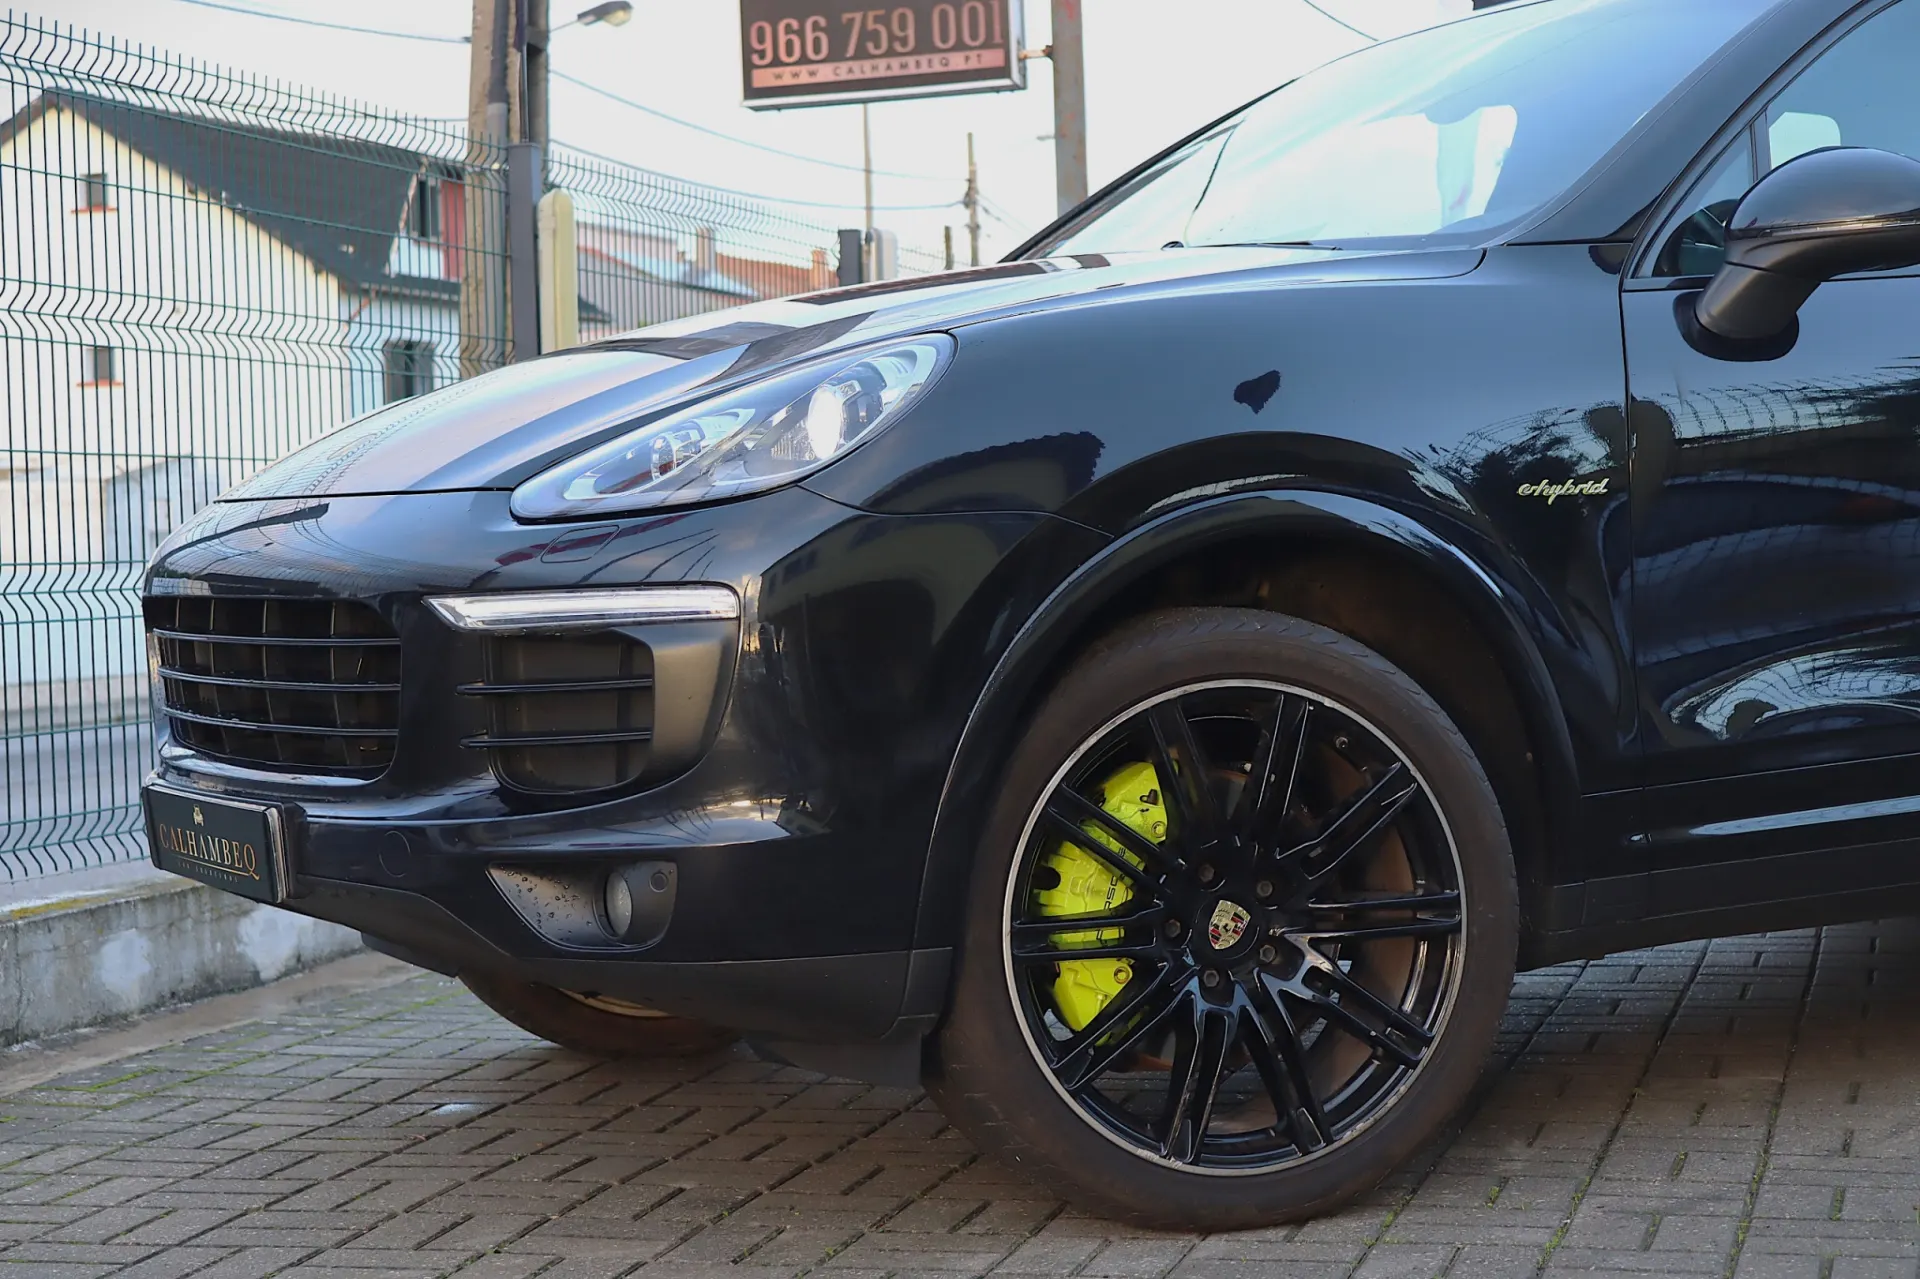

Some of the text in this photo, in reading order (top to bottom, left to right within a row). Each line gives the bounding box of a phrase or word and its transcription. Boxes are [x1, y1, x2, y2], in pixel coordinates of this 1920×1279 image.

[750, 0, 1005, 66] 966 759 001
[159, 823, 260, 881] CALHAMBEQ
